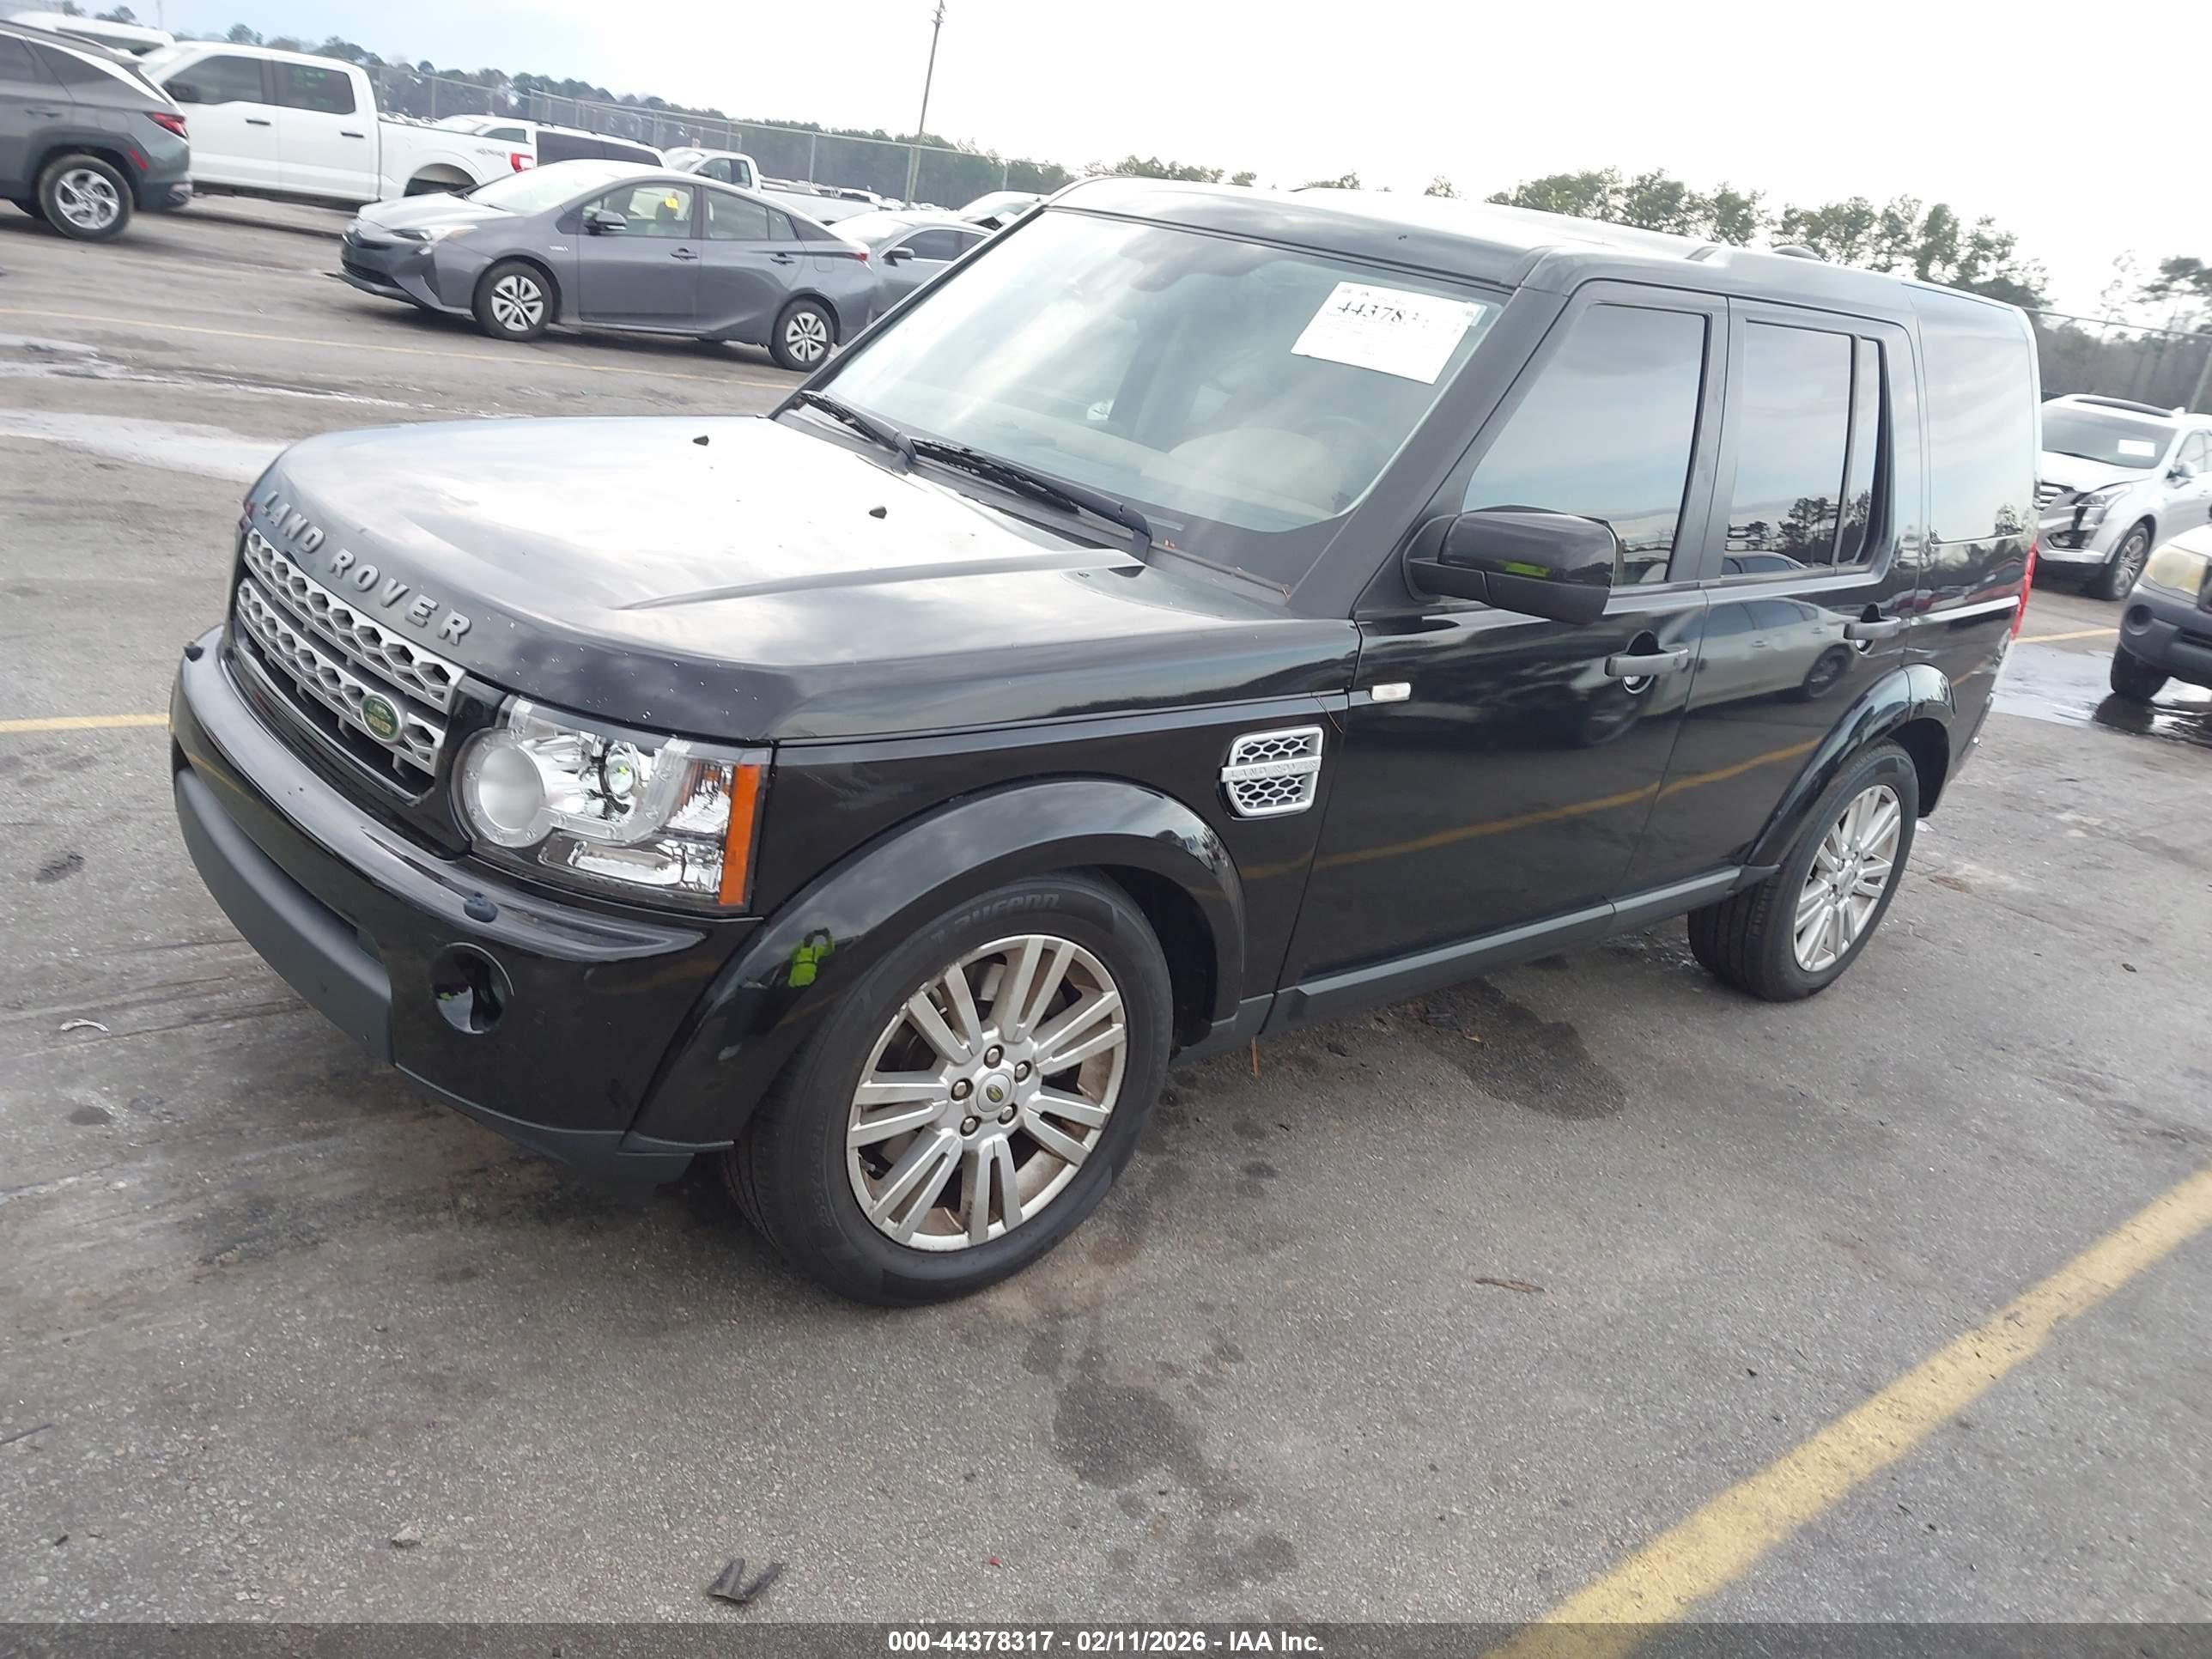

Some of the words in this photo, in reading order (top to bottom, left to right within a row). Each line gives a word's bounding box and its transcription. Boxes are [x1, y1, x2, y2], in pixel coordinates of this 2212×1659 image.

[1337, 301, 1431, 329] 44378
[261, 490, 325, 554] LAND
[329, 548, 472, 646] ROVER
